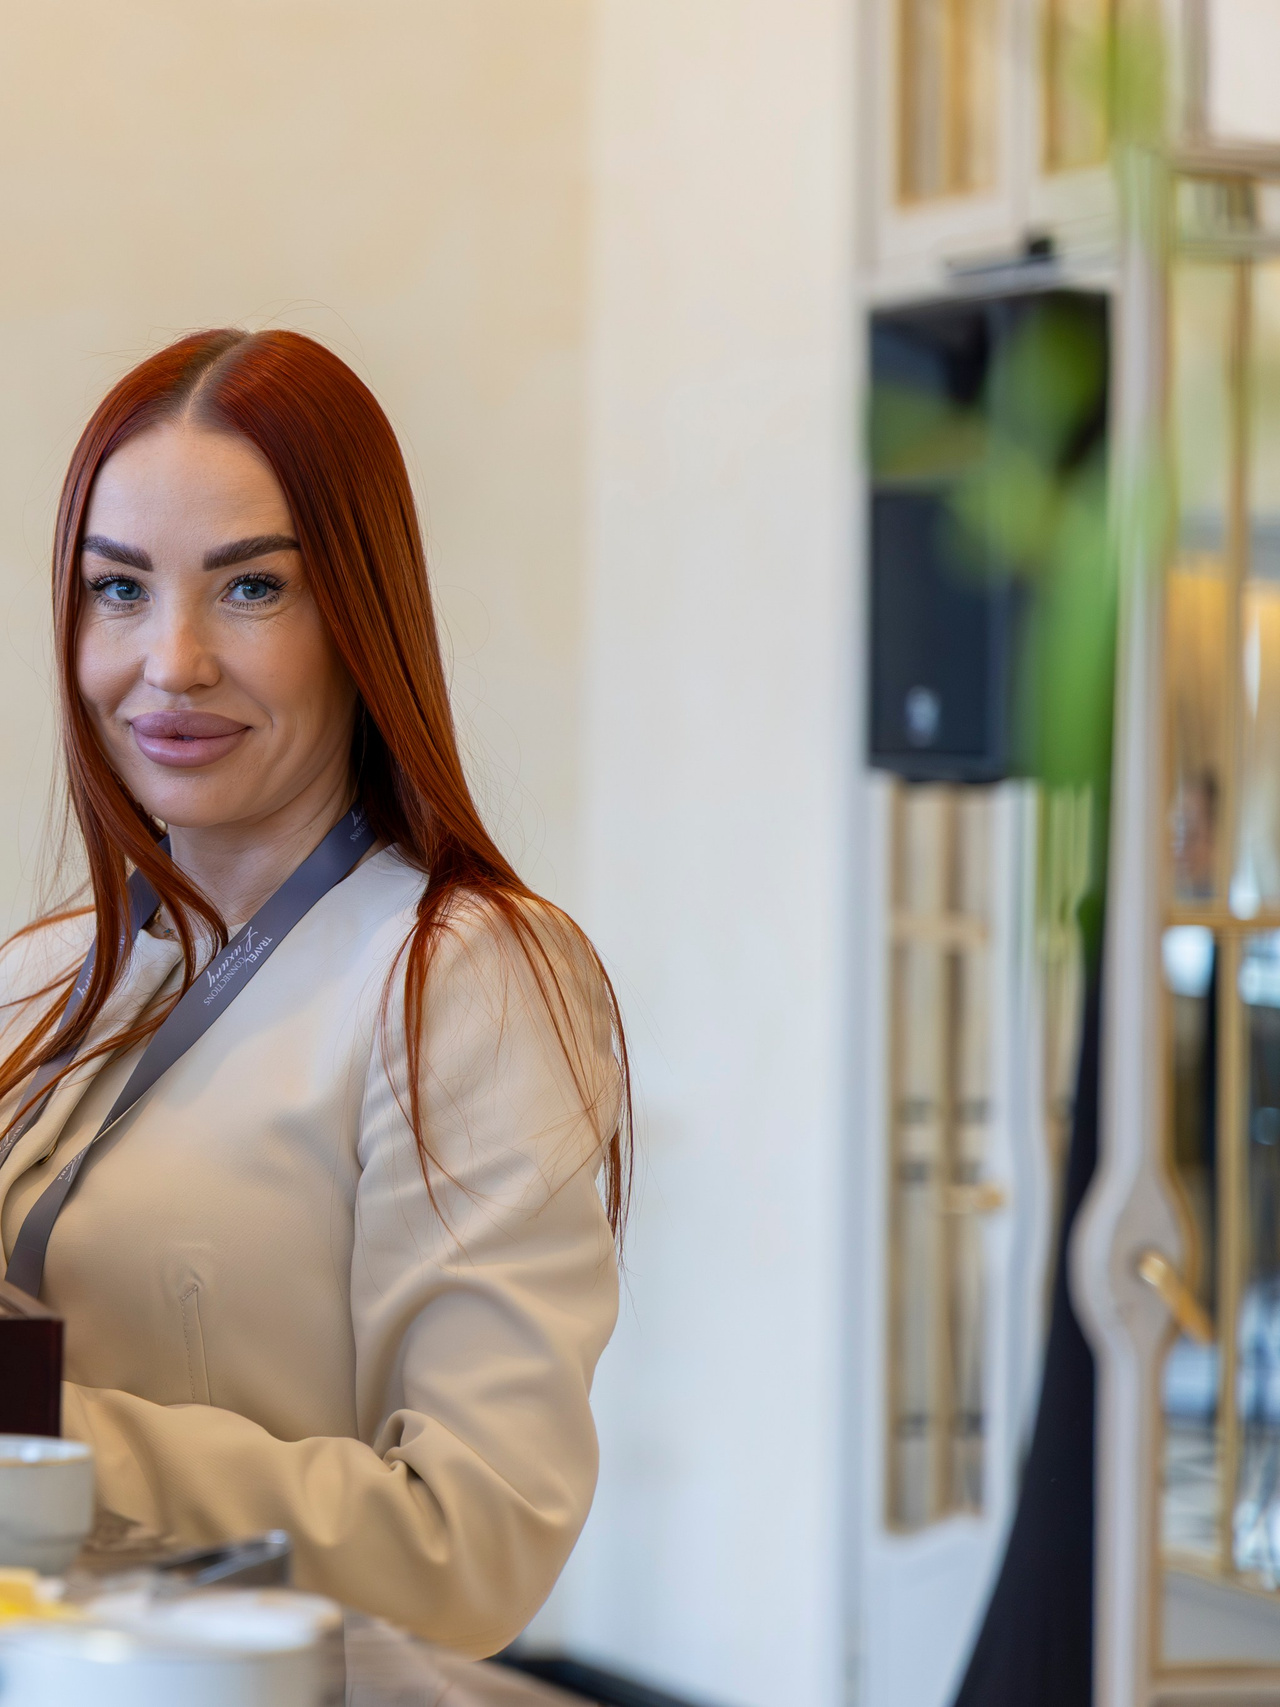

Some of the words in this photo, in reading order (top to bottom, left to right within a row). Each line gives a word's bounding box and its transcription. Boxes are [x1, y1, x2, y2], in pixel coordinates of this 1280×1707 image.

[206, 926, 258, 988] Luxury
[246, 936, 273, 964] TRAVEL
[203, 956, 245, 1006] CONNECTIONS
